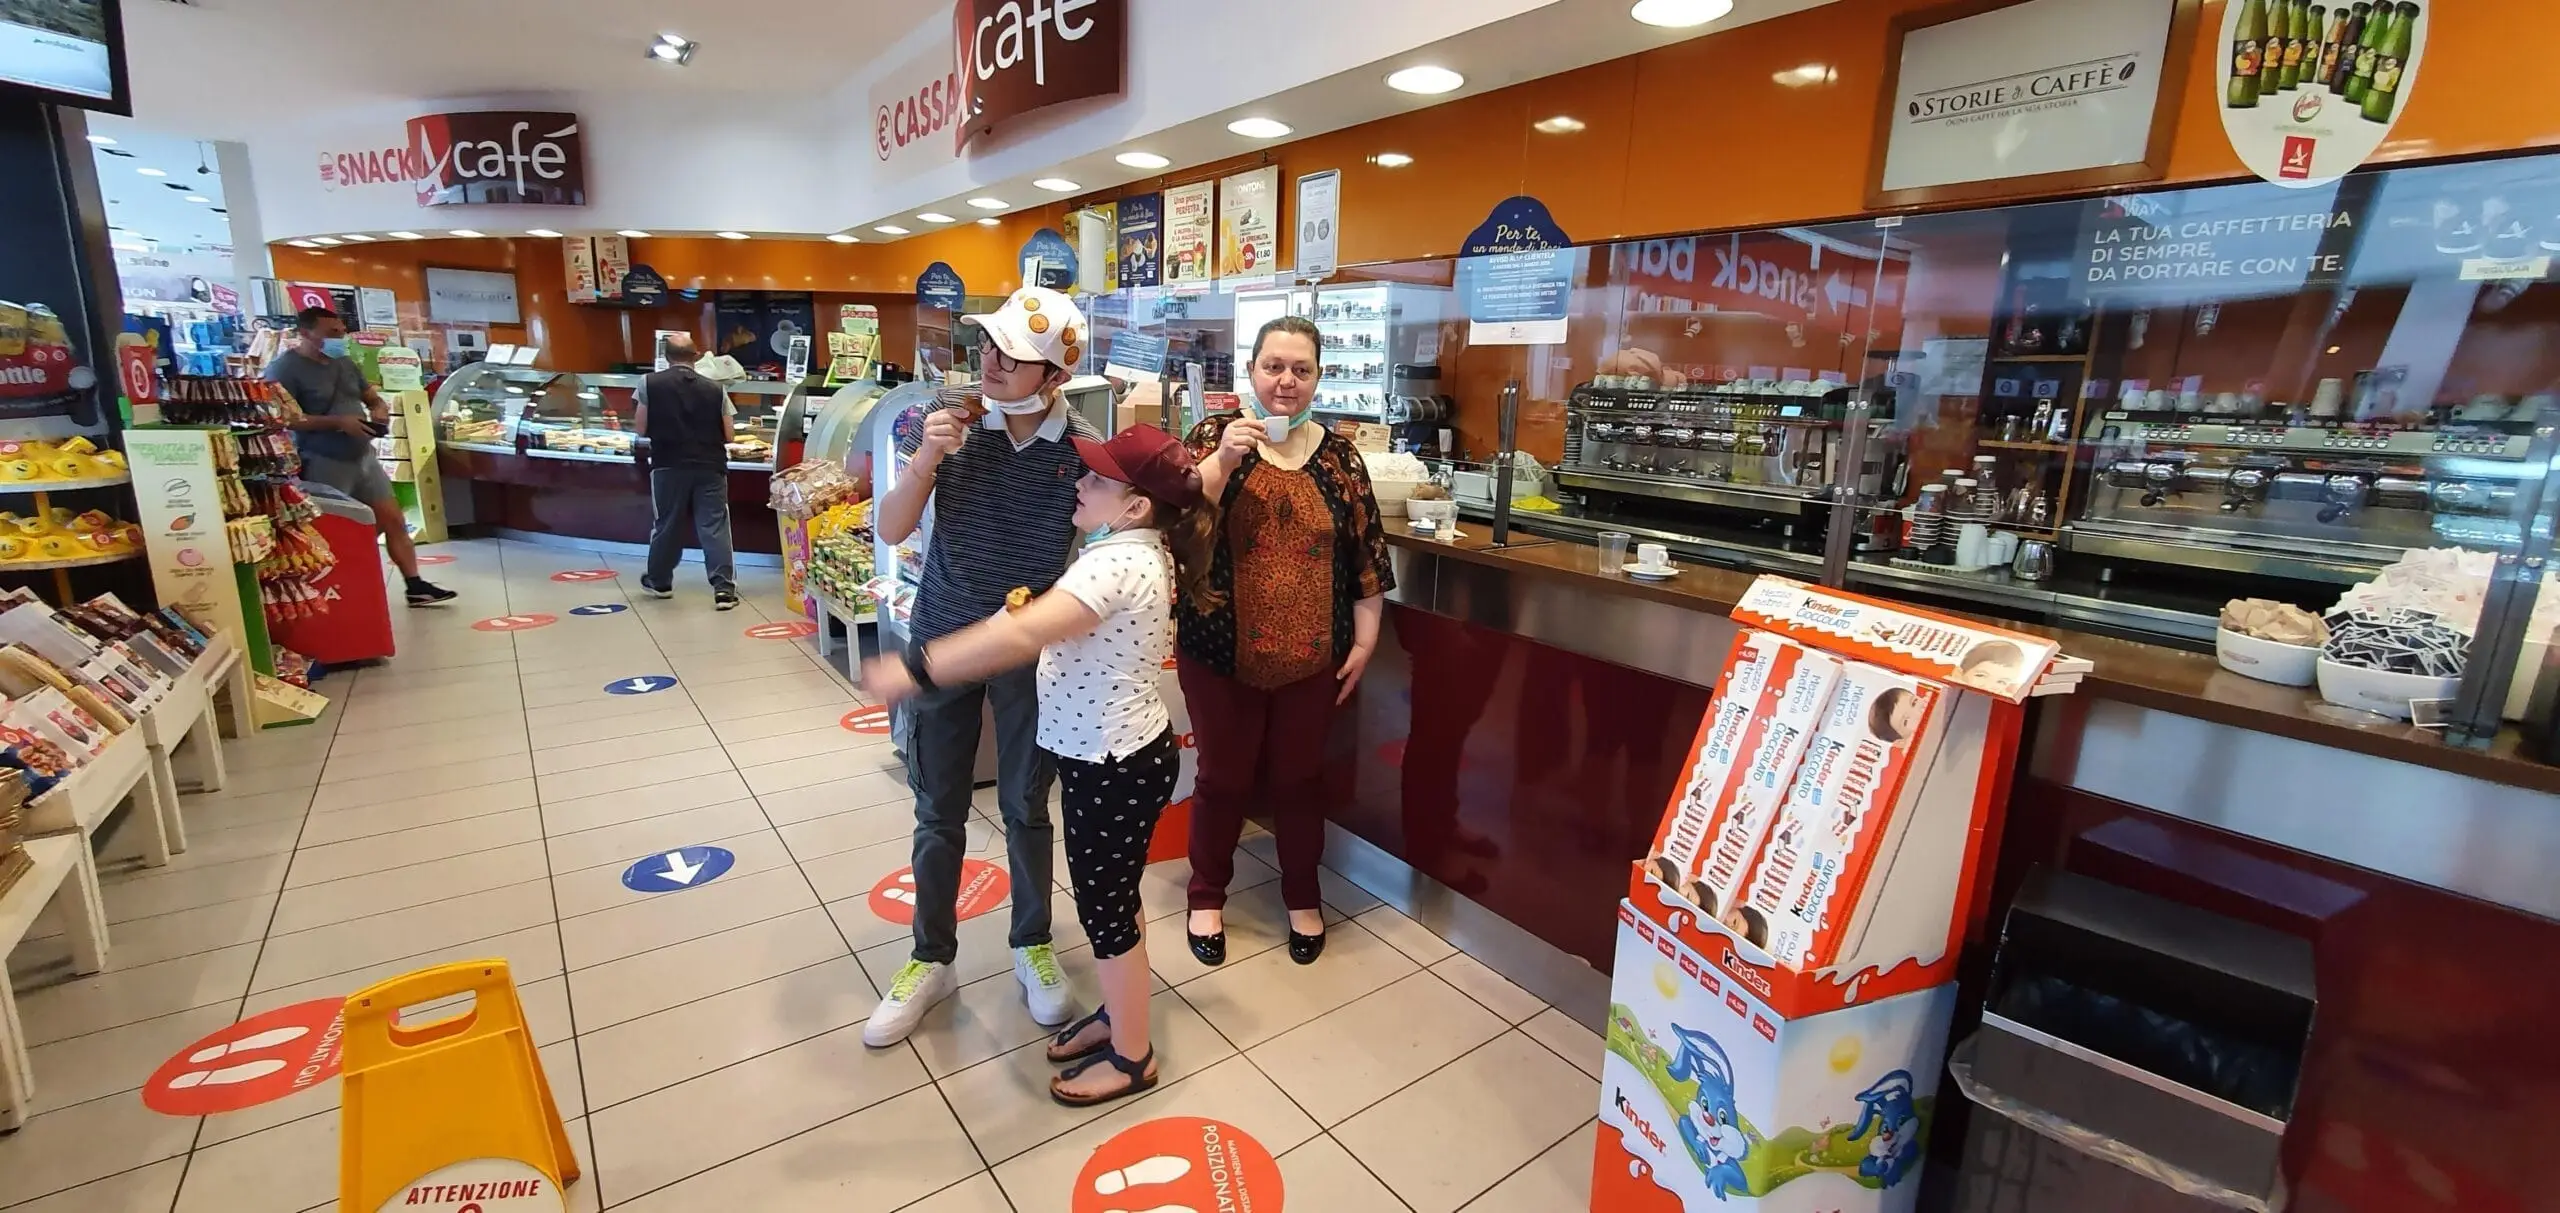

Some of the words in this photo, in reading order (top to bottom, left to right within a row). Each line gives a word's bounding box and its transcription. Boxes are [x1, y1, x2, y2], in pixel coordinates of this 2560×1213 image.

[1922, 87, 2005, 117] STORIE
[2031, 63, 2113, 97] CAFFÈ
[894, 72, 957, 148] CASSA
[337, 147, 414, 186] SNACK
[453, 121, 578, 196] café
[1495, 224, 1522, 243] Per
[2094, 229, 2121, 245] LA
[2129, 225, 2173, 241] TUA
[2181, 211, 2352, 239] CAFFETTERIA
[2088, 266, 2116, 282] DA
[2124, 260, 2232, 281] PORTARE
[2239, 255, 2298, 275] CON
[2306, 254, 2344, 273] TE.
[2091, 248, 2113, 263] DI
[2119, 241, 2216, 262] SEMPRE,
[1802, 859, 1836, 923] CIOCCOLATO
[292, 1064, 320, 1088] QUI
[1227, 1139, 1244, 1176] MANTIENI
[1236, 1177, 1246, 1187] LA
[406, 1179, 541, 1206] ATTENZIONE
